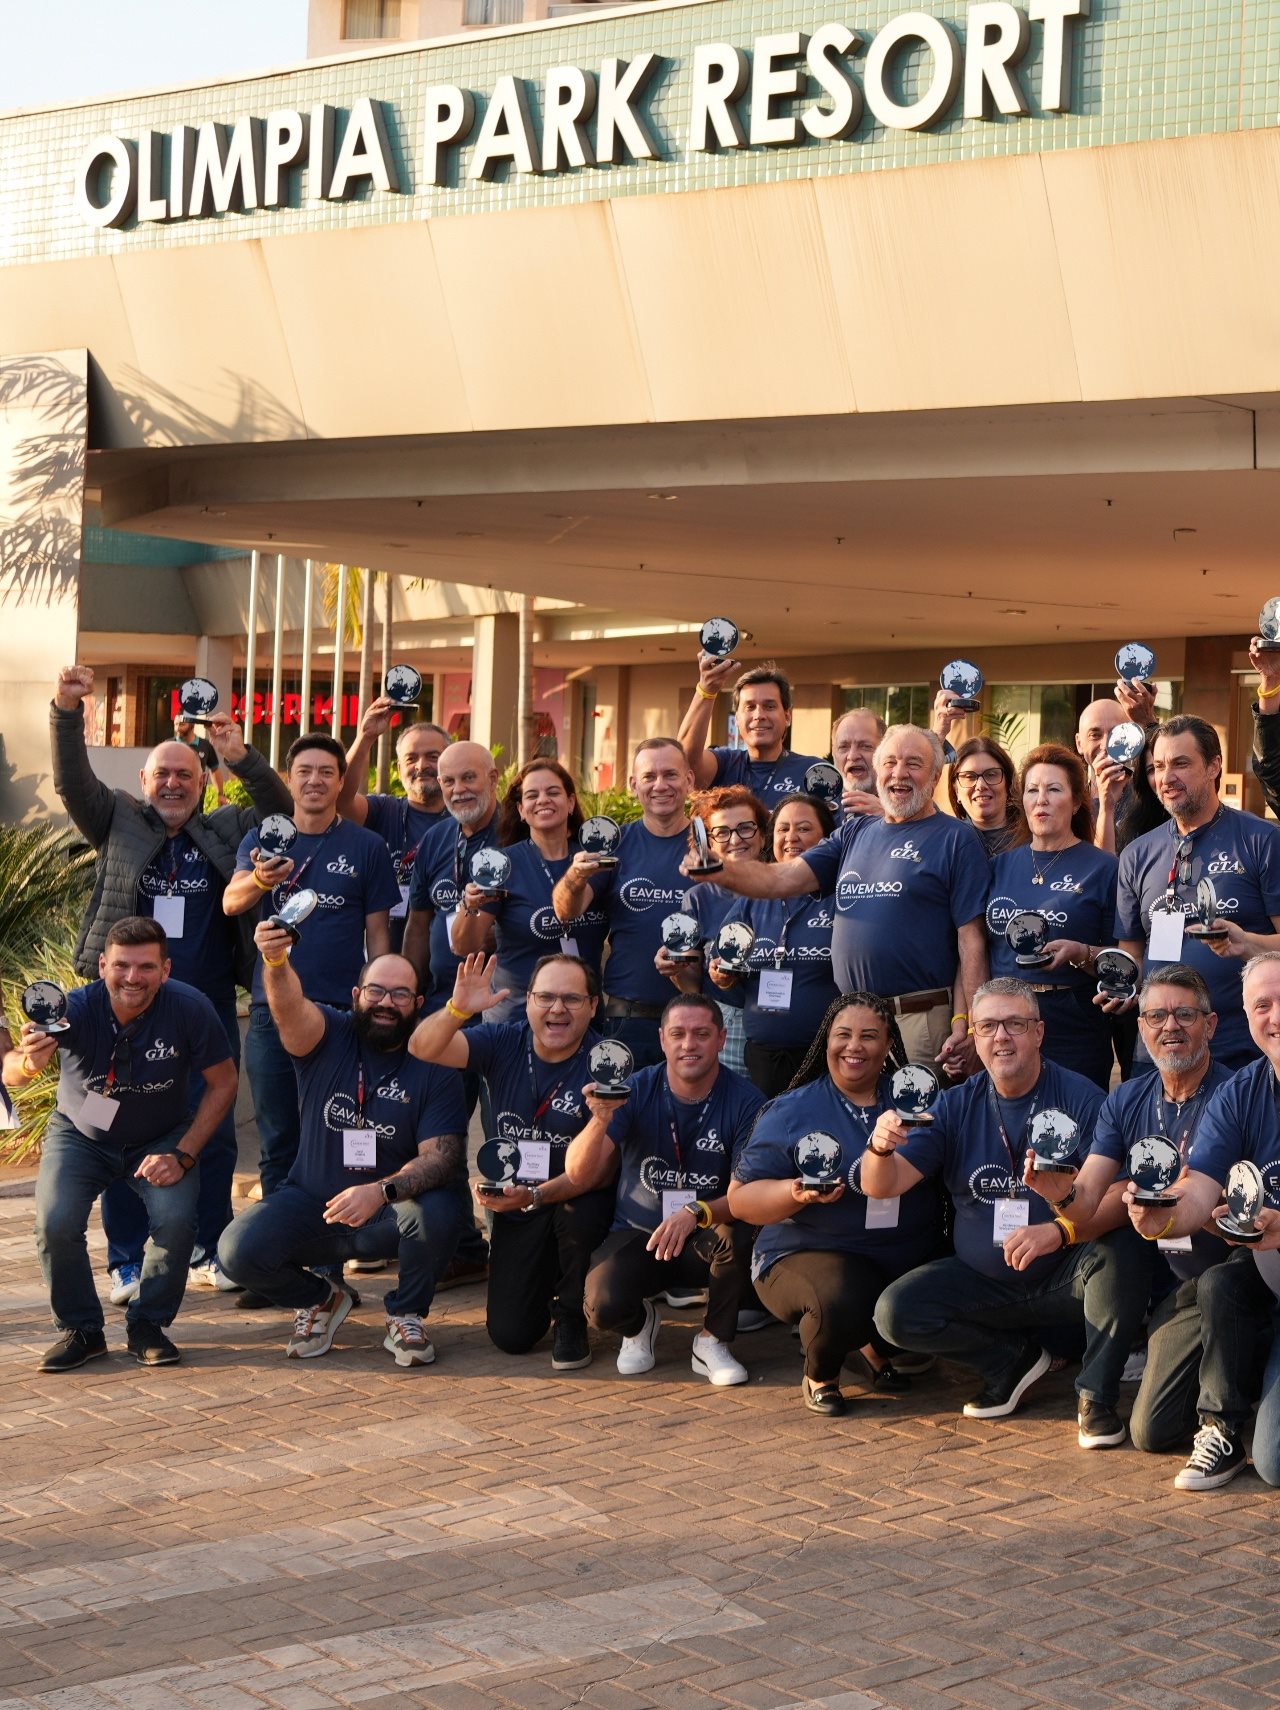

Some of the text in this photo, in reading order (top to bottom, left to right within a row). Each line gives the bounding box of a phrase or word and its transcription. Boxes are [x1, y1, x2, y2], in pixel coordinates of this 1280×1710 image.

[75, 0, 1089, 229] OLIMPIA PARK RESORT
[891, 848, 920, 858] GTA
[327, 862, 355, 874] GTA
[1208, 861, 1239, 872] GTA
[181, 877, 209, 889] 360
[841, 881, 903, 895] EAVEM 360
[1050, 881, 1080, 890] GTA
[317, 893, 345, 906] 360
[629, 887, 673, 900] EAVEM
[1216, 898, 1239, 910] 60
[798, 946, 833, 957] 360
[146, 1046, 175, 1060] GTA
[377, 1087, 407, 1100] GTA
[552, 1098, 580, 1114] GTA
[696, 1138, 725, 1151] GTA
[689, 1172, 720, 1186] 360
